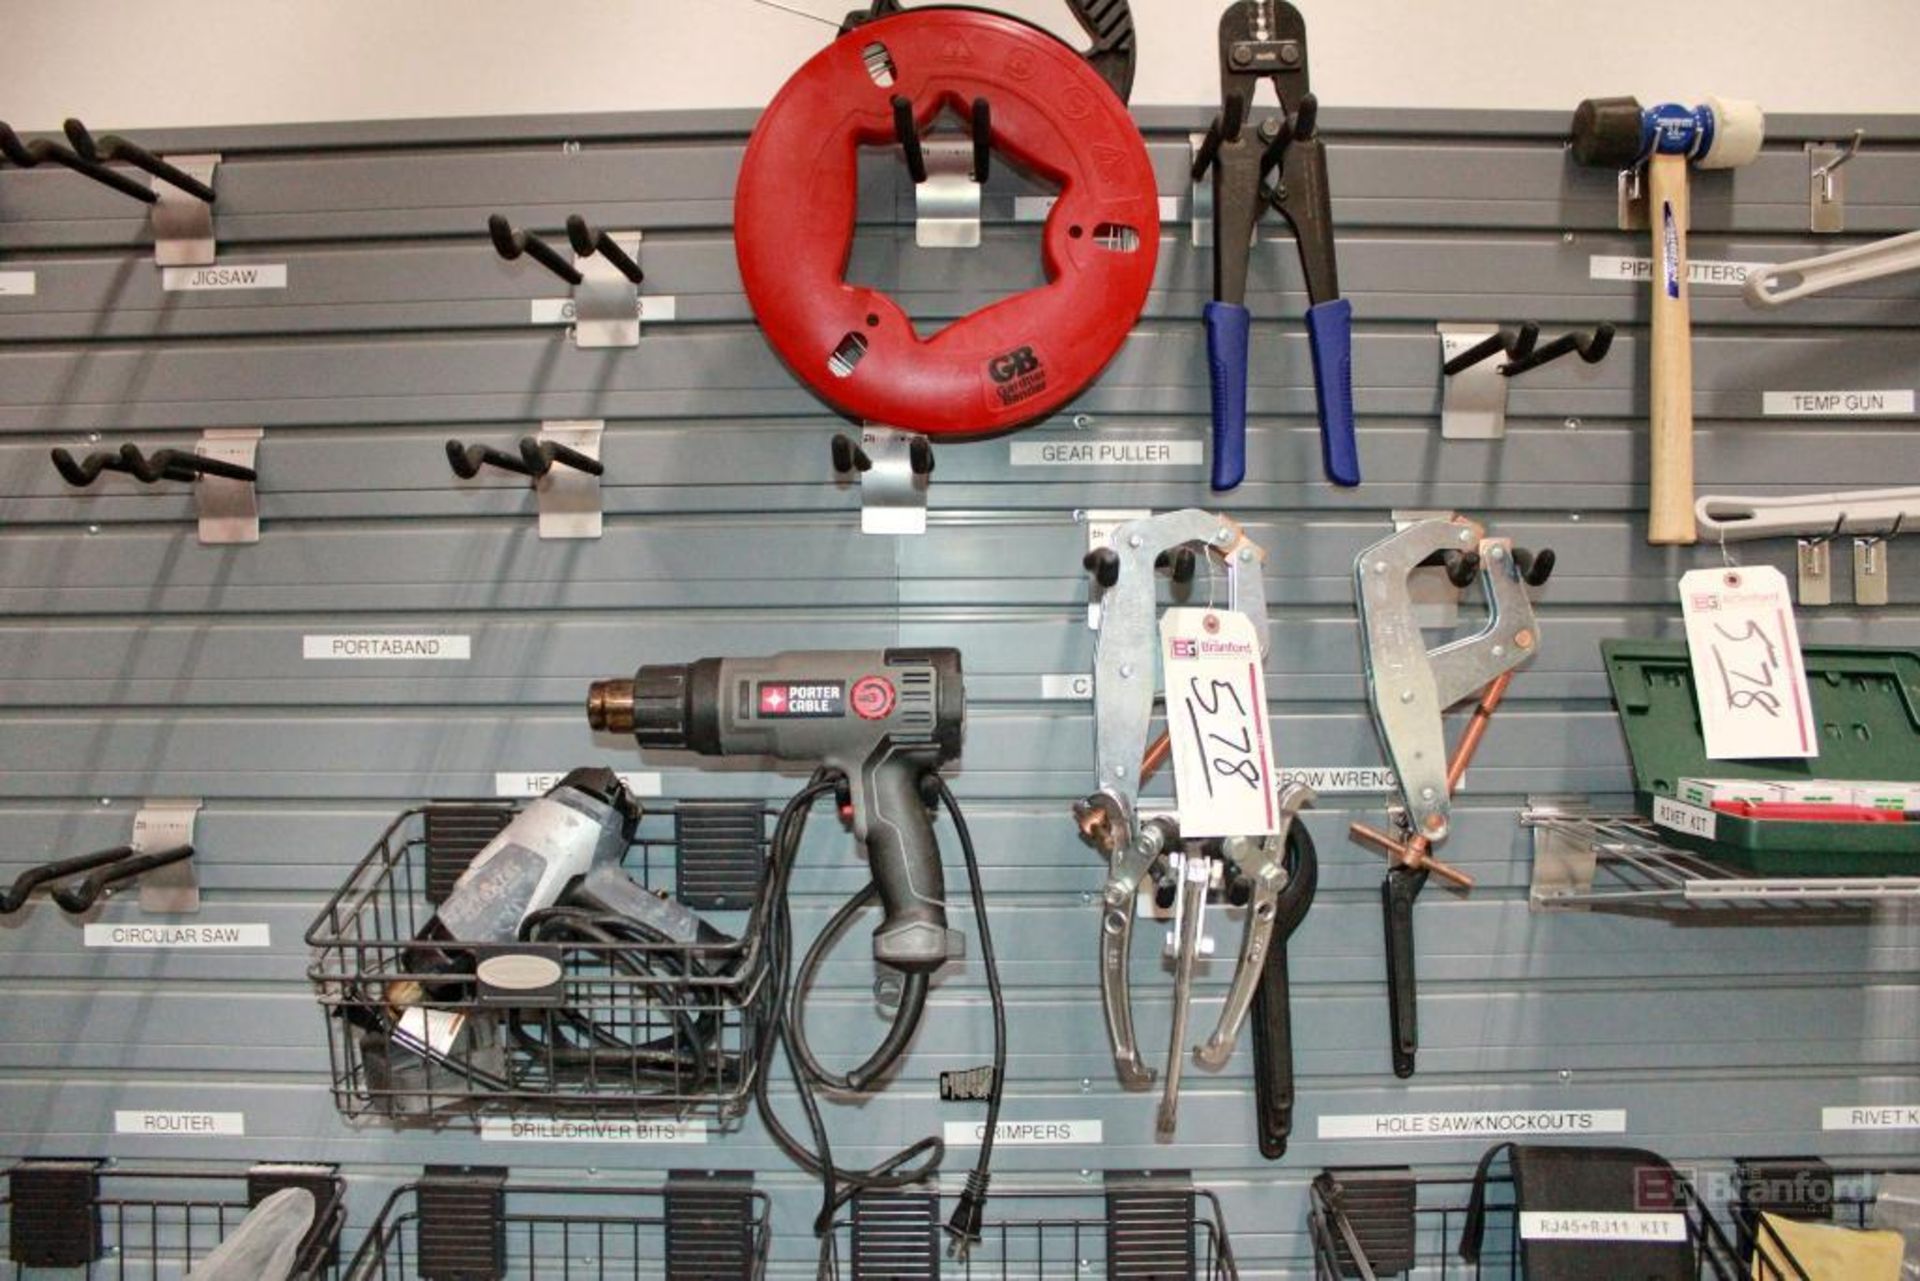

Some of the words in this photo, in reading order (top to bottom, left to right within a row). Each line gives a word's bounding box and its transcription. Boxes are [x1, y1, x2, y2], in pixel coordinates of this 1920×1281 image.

[192, 269, 258, 286] JIGSAW
[1620, 260, 1653, 277] PIP
[1686, 263, 1747, 282] TTERS
[988, 345, 1039, 384] GB
[1793, 395, 1841, 411] TEMP
[1845, 394, 1884, 411] GUN
[1041, 444, 1094, 462] GEAR
[1099, 444, 1171, 462] PULLER
[331, 639, 440, 656] PORTABAND
[1713, 618, 1782, 718] 578
[788, 686, 841, 700] PORTER
[788, 699, 829, 713] CABLE
[1190, 676, 1260, 791] 578
[1330, 770, 1396, 788] WRENC
[1660, 803, 1687, 826] RIVET
[1690, 813, 1707, 834] KIT
[111, 927, 198, 944] CIRCULAR
[201, 928, 241, 943] SAW
[143, 1115, 215, 1131] ROUTER
[1375, 1116, 1424, 1133] HOLE
[1428, 1112, 1593, 1132] SAW/KNOCKOUTS
[1851, 1109, 1903, 1125] RIVET
[511, 1121, 632, 1140] DRILL/DRIVER
[636, 1122, 677, 1140] BITS
[975, 1123, 1071, 1140] CRIMPERS
[1540, 1219, 1630, 1234] RJ45+RJ11
[1640, 1221, 1670, 1236] KIT
